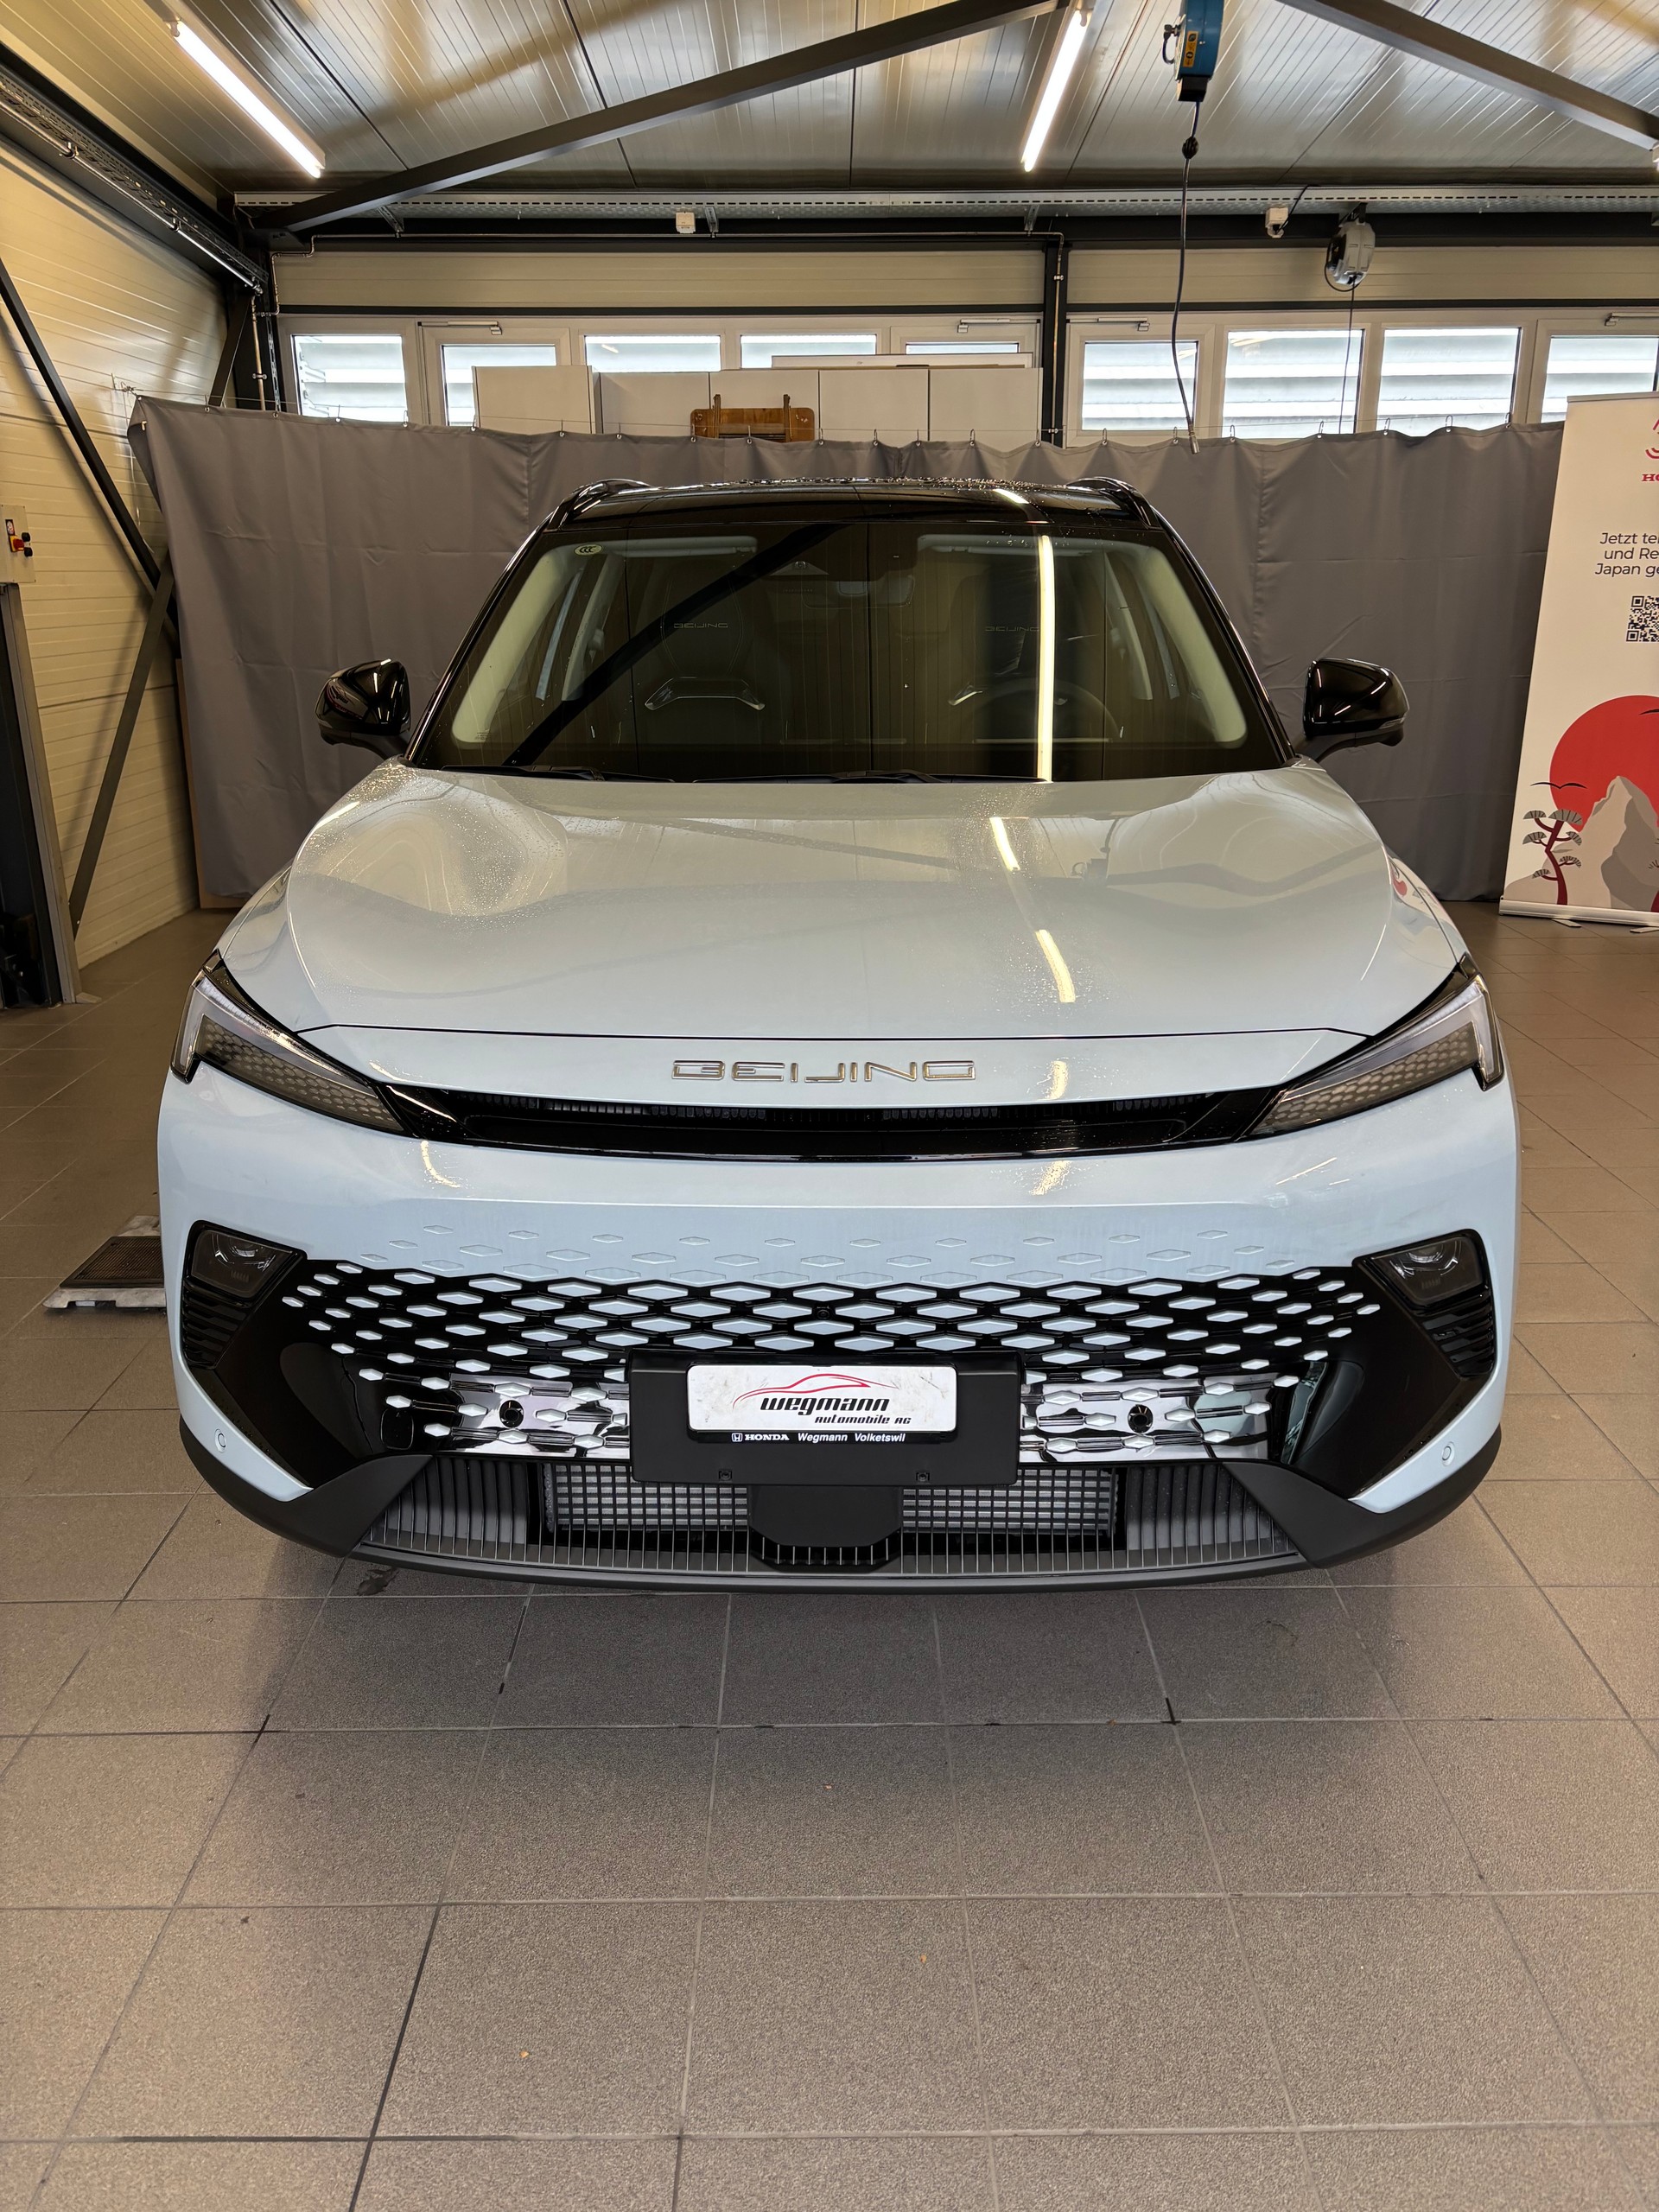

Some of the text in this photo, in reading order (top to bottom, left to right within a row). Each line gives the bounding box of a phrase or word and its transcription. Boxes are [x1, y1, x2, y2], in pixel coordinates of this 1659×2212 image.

[1599, 532, 1638, 544] Jetzt
[1604, 547, 1635, 560] und
[1595, 563, 1641, 577] Japan
[671, 1060, 976, 1083] BEIJING
[760, 1397, 890, 1415] wegmann
[798, 1433, 848, 1444] Wegmann
[855, 1433, 906, 1442] Volketswil
